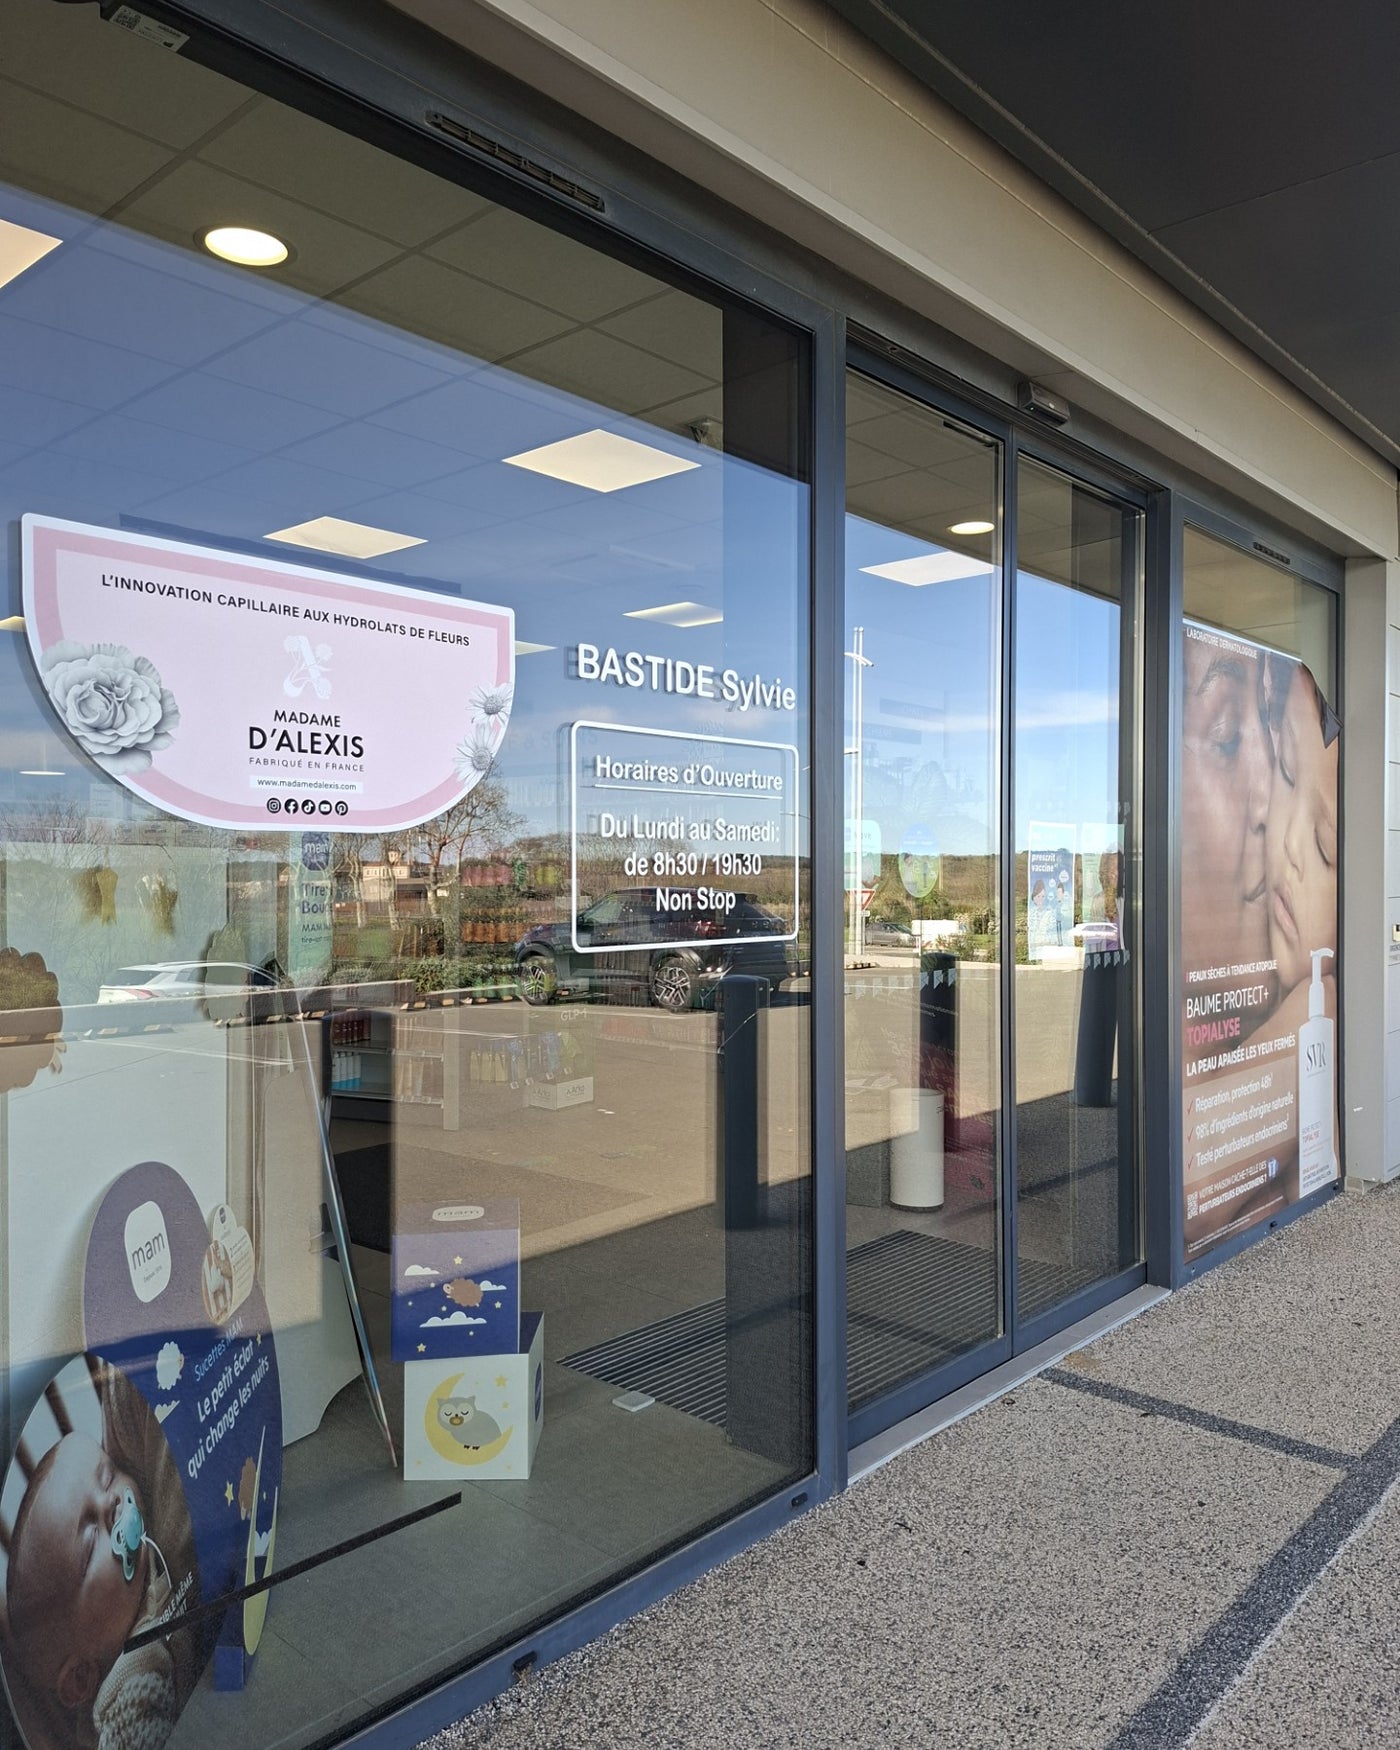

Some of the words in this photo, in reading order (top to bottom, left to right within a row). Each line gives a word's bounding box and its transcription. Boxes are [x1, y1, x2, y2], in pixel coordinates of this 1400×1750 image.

[102, 574, 212, 604] L'INNOVATION
[217, 594, 300, 618] CAPILLAIRE
[303, 609, 330, 623] AUX
[333, 613, 407, 636] HYDROLATS
[410, 626, 425, 639] DE
[428, 630, 470, 647] FLEURS
[577, 643, 714, 698] BASTIDE
[722, 669, 796, 712] Sylvie
[273, 709, 341, 728] MADAME
[249, 726, 364, 758] D'ALEXIS
[249, 756, 303, 768] FABRIQUÉ
[307, 761, 321, 769] EN
[325, 762, 365, 772] FRANCE
[596, 754, 679, 784] Horaires
[683, 763, 784, 791] d'Ouverture
[257, 779, 357, 791] www.madamedalexis.com
[601, 812, 628, 839] Du
[633, 813, 685, 841] Lundi
[689, 822, 711, 841] au
[714, 817, 781, 843] Samedi:
[624, 852, 648, 877] de
[653, 851, 698, 877] 8h30
[701, 853, 707, 877] /
[714, 852, 762, 877] 19h30
[656, 887, 692, 912] Non
[697, 886, 737, 915] Stop
[1189, 970, 1207, 983] PEAUX
[1207, 966, 1226, 980] SÈCHES
[1231, 963, 1256, 976] TENDANCE
[1186, 993, 1222, 1019] BAUME
[1223, 985, 1269, 1011] PROTECT+
[1185, 1017, 1240, 1047] TOPIALYSE
[1186, 1062, 1197, 1077] LA
[1197, 1055, 1217, 1073] PEAU
[1217, 1045, 1245, 1068] APAISÉE
[1245, 1046, 1257, 1060] LES
[1256, 1039, 1274, 1056] YEUX
[1274, 1032, 1296, 1051] FERMÉS
[1305, 1041, 1327, 1073] SVR
[1231, 1080, 1260, 1104] protection
[1195, 1146, 1213, 1167] Testé
[1213, 1133, 1255, 1163] perturbateurs
[131, 1232, 165, 1270] mam
[194, 1338, 227, 1382] Sucettes
[226, 1315, 245, 1346] MAM
[197, 1397, 211, 1423] Le
[211, 1364, 234, 1412] petit
[233, 1338, 254, 1378] éclat
[187, 1437, 206, 1480] qui
[205, 1399, 241, 1454] change
[238, 1379, 252, 1408] les
[250, 1354, 270, 1391] nuits
